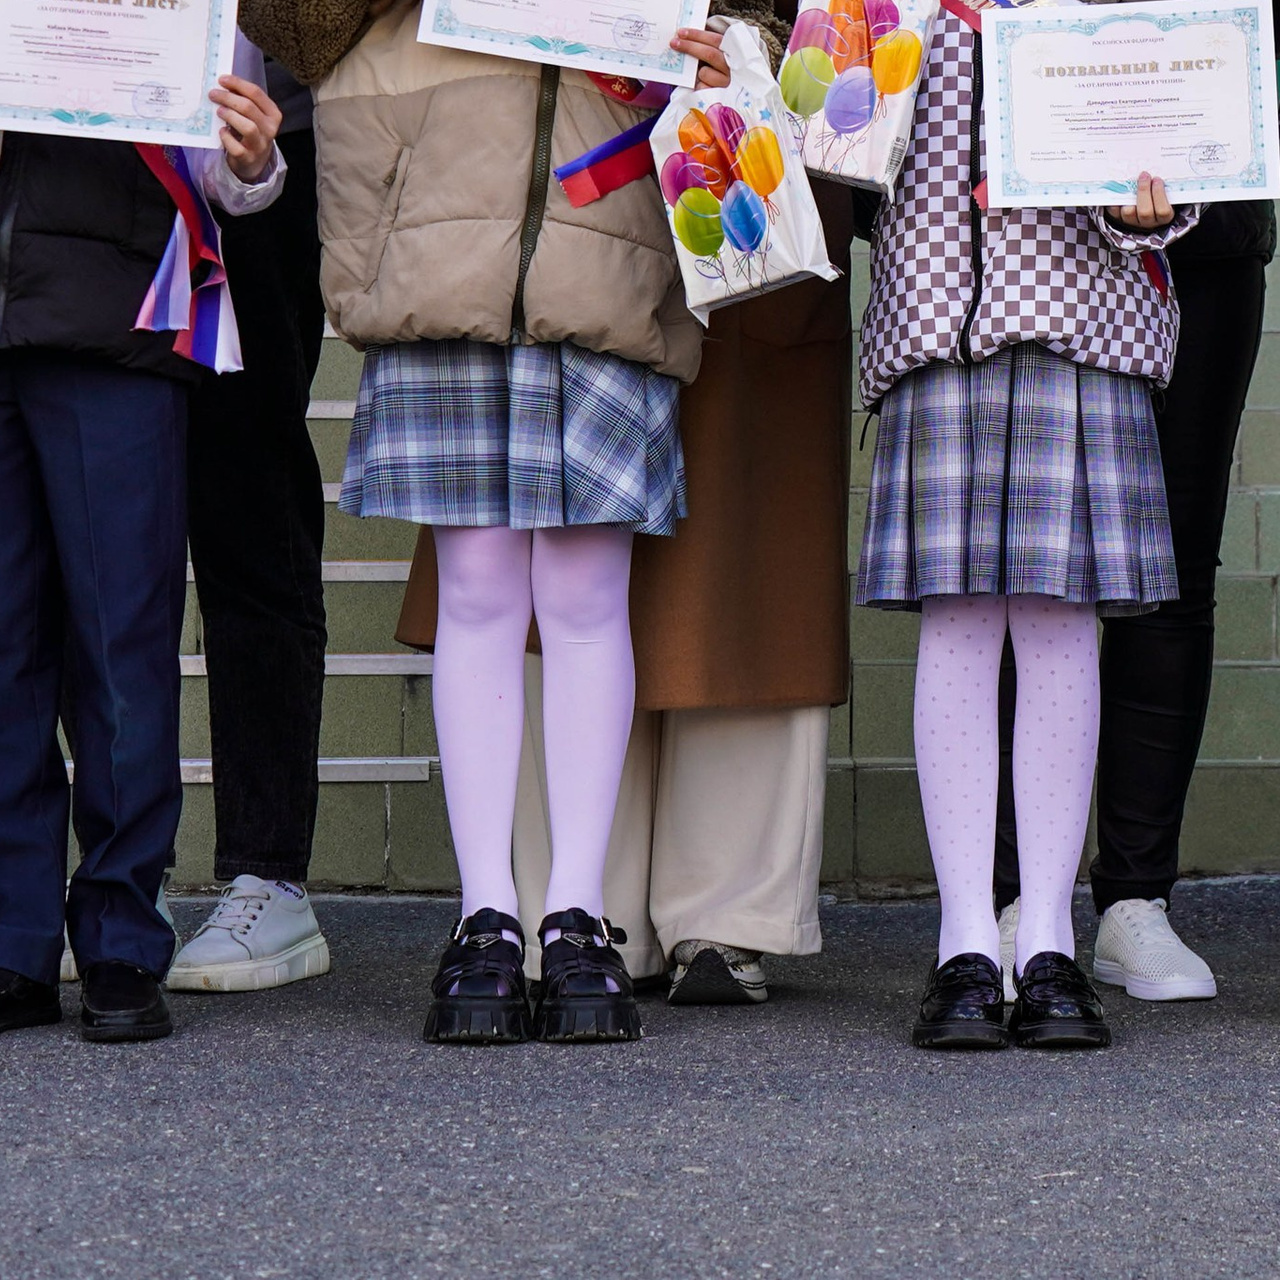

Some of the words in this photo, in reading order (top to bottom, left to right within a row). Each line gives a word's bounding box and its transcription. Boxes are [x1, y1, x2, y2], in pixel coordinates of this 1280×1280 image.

[1044, 61, 1159, 78] ПОХВАЛЬНЫЙ
[1169, 58, 1216, 71] ЛИСТ
[1148, 96, 1179, 104] Георгиевна
